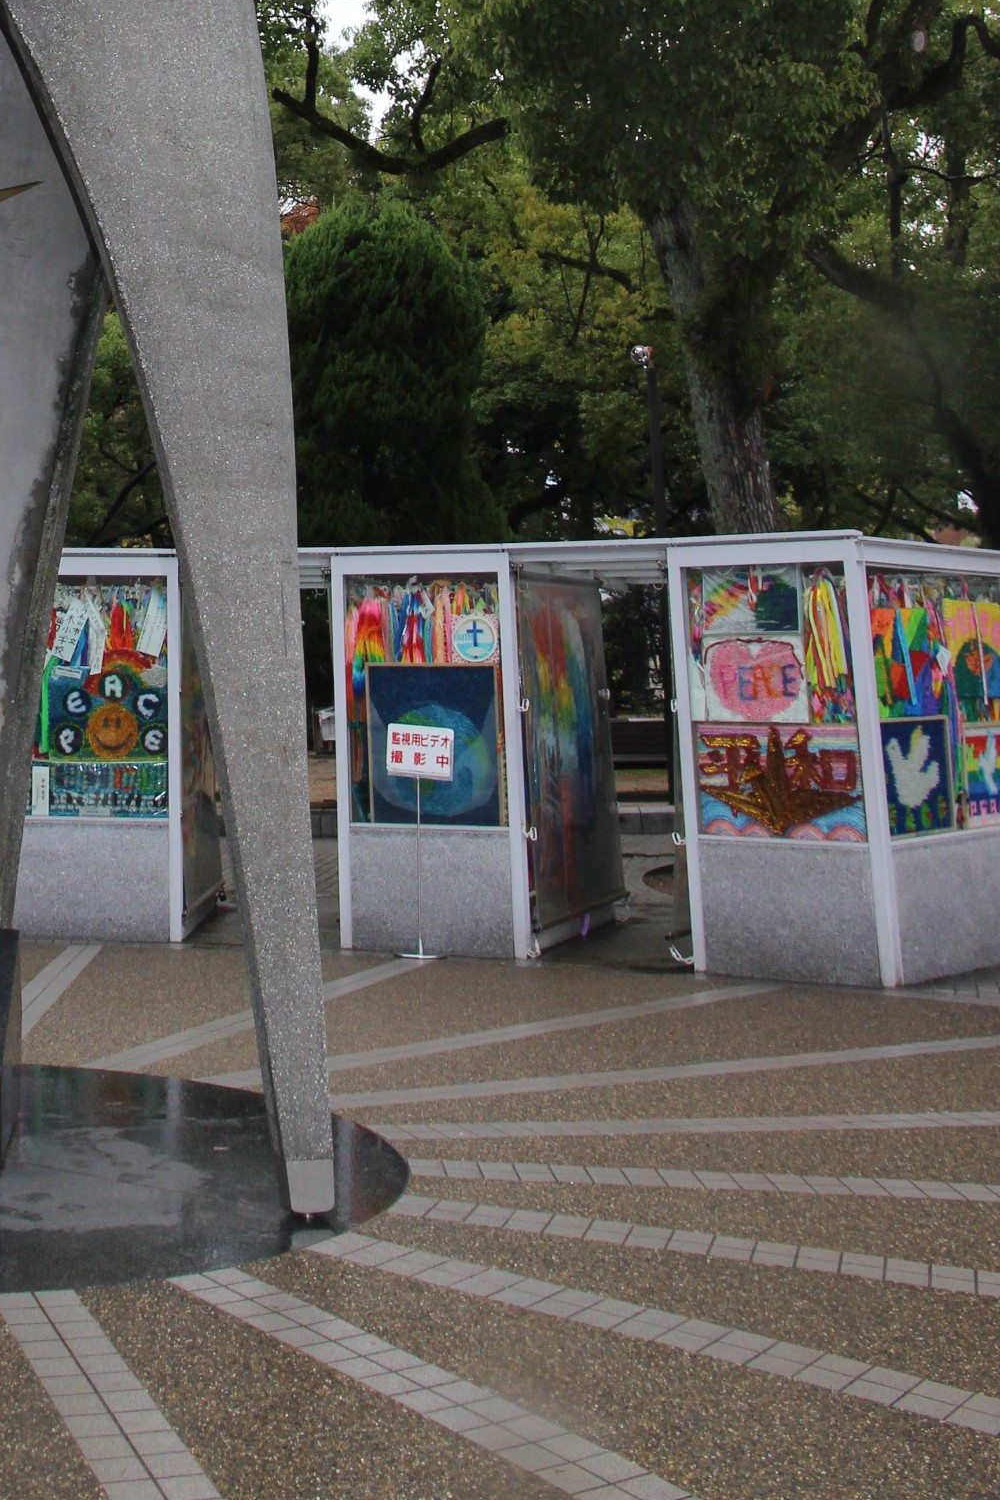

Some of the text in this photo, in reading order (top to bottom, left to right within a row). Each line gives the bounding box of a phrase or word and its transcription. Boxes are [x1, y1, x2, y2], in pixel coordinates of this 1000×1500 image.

[720, 663, 797, 700] PEACE
[391, 732, 450, 749] 監視用ビデオ
